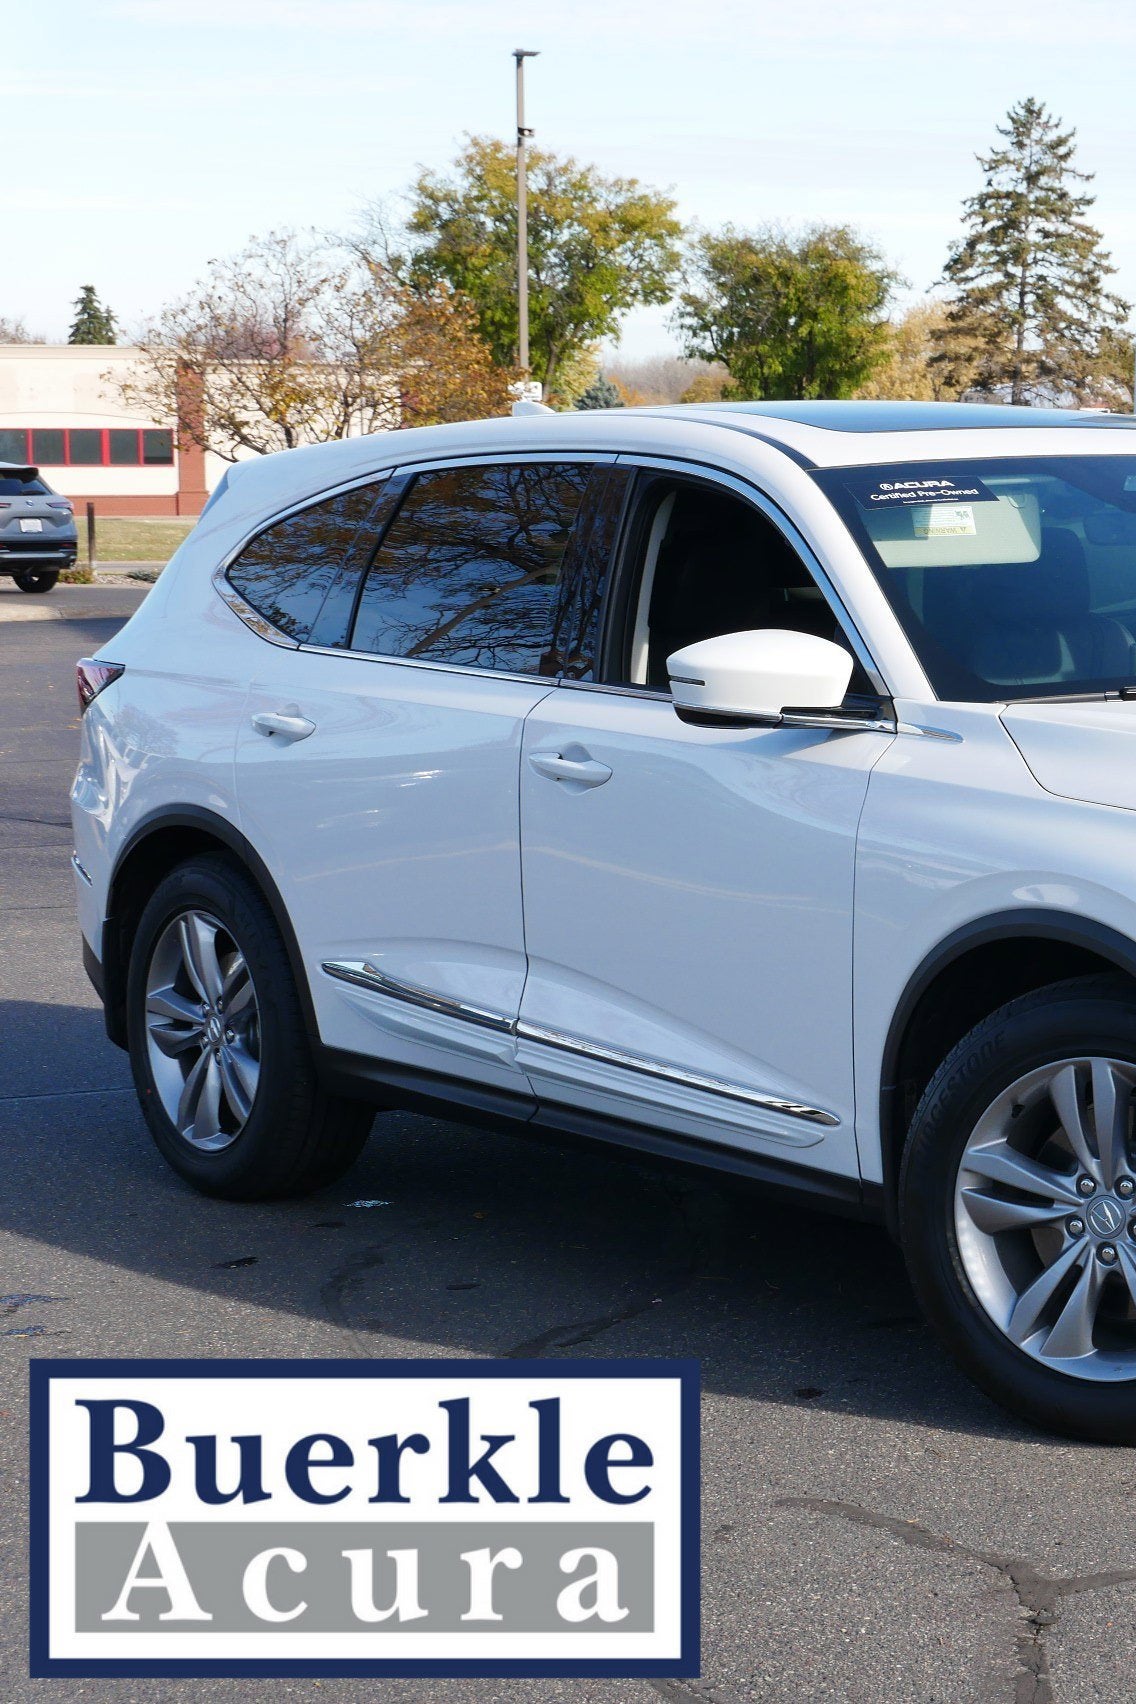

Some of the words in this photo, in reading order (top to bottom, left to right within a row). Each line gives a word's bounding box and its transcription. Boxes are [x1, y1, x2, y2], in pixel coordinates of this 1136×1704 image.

[894, 480, 955, 490] ACURA
[870, 490, 916, 501] Certified
[917, 488, 980, 497] Pre-Owned
